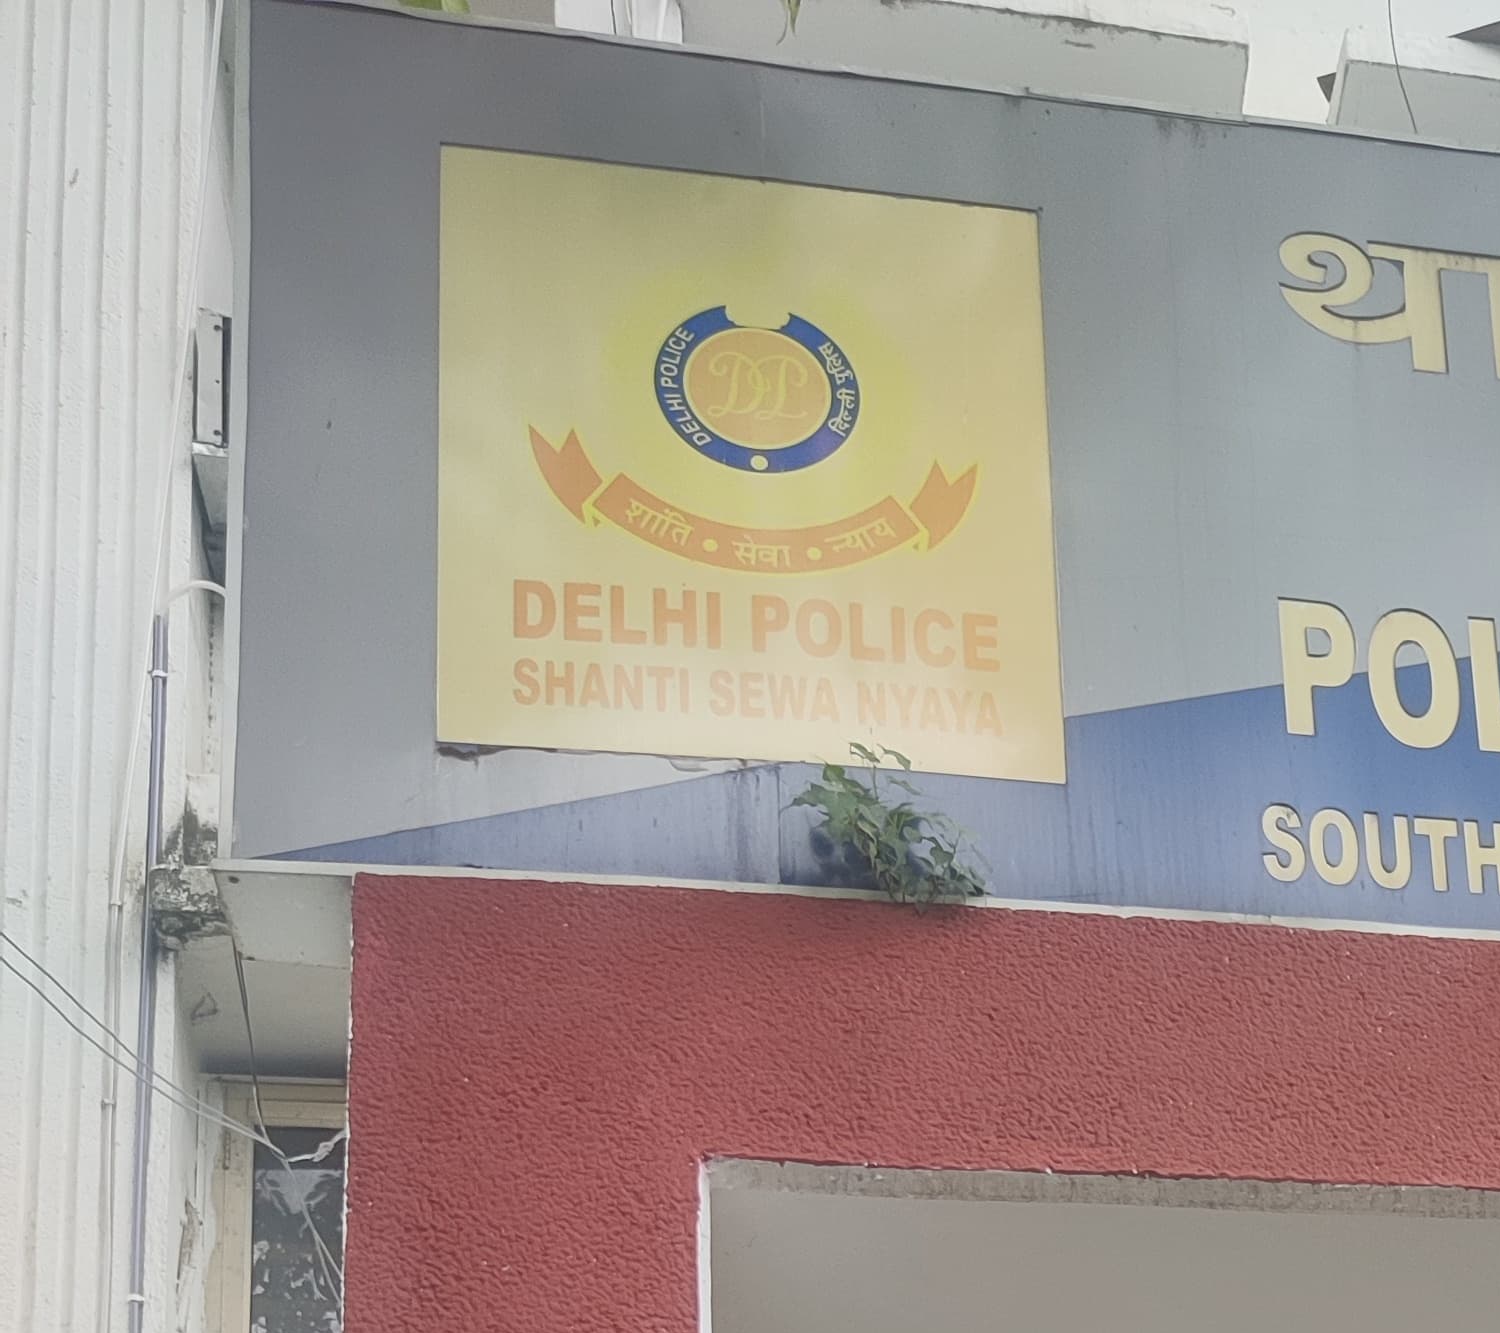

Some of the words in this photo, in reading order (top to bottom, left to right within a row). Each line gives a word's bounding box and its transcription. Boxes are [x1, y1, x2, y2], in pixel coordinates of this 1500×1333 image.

[659, 327, 696, 389] POLICE
[663, 393, 713, 447] DELHI
[731, 534, 793, 569] सेवा
[512, 578, 722, 651] DELHI
[749, 593, 1001, 673] POLICE
[512, 656, 691, 714] SHANTI
[708, 669, 841, 724] SEWA
[855, 680, 1005, 738] NYAYA
